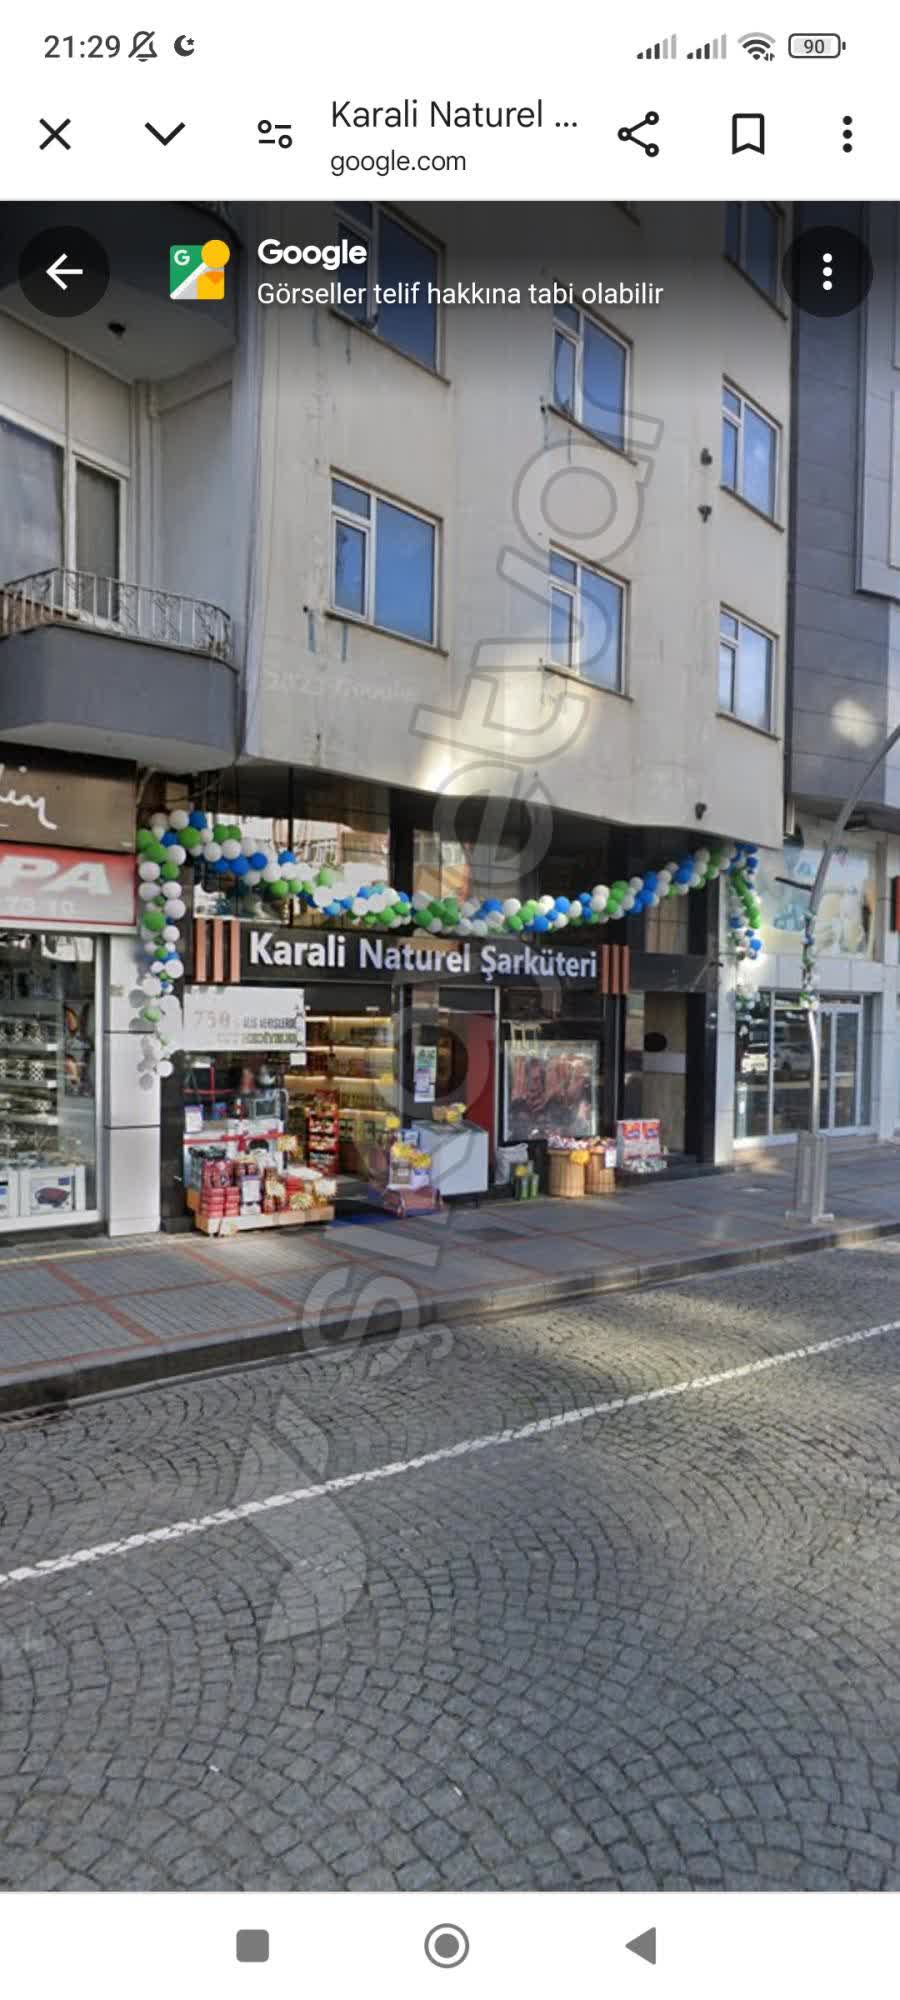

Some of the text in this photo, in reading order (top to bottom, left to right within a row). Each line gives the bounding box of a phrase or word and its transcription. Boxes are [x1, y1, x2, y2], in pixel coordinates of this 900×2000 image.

[44, 34, 121, 59] 21:29
[803, 39, 825, 54] 90
[332, 98, 418, 128] Karali
[430, 98, 542, 128] Naturel
[330, 150, 466, 176] google.com
[249, 930, 597, 982] Karali Naturel Şarküteri
